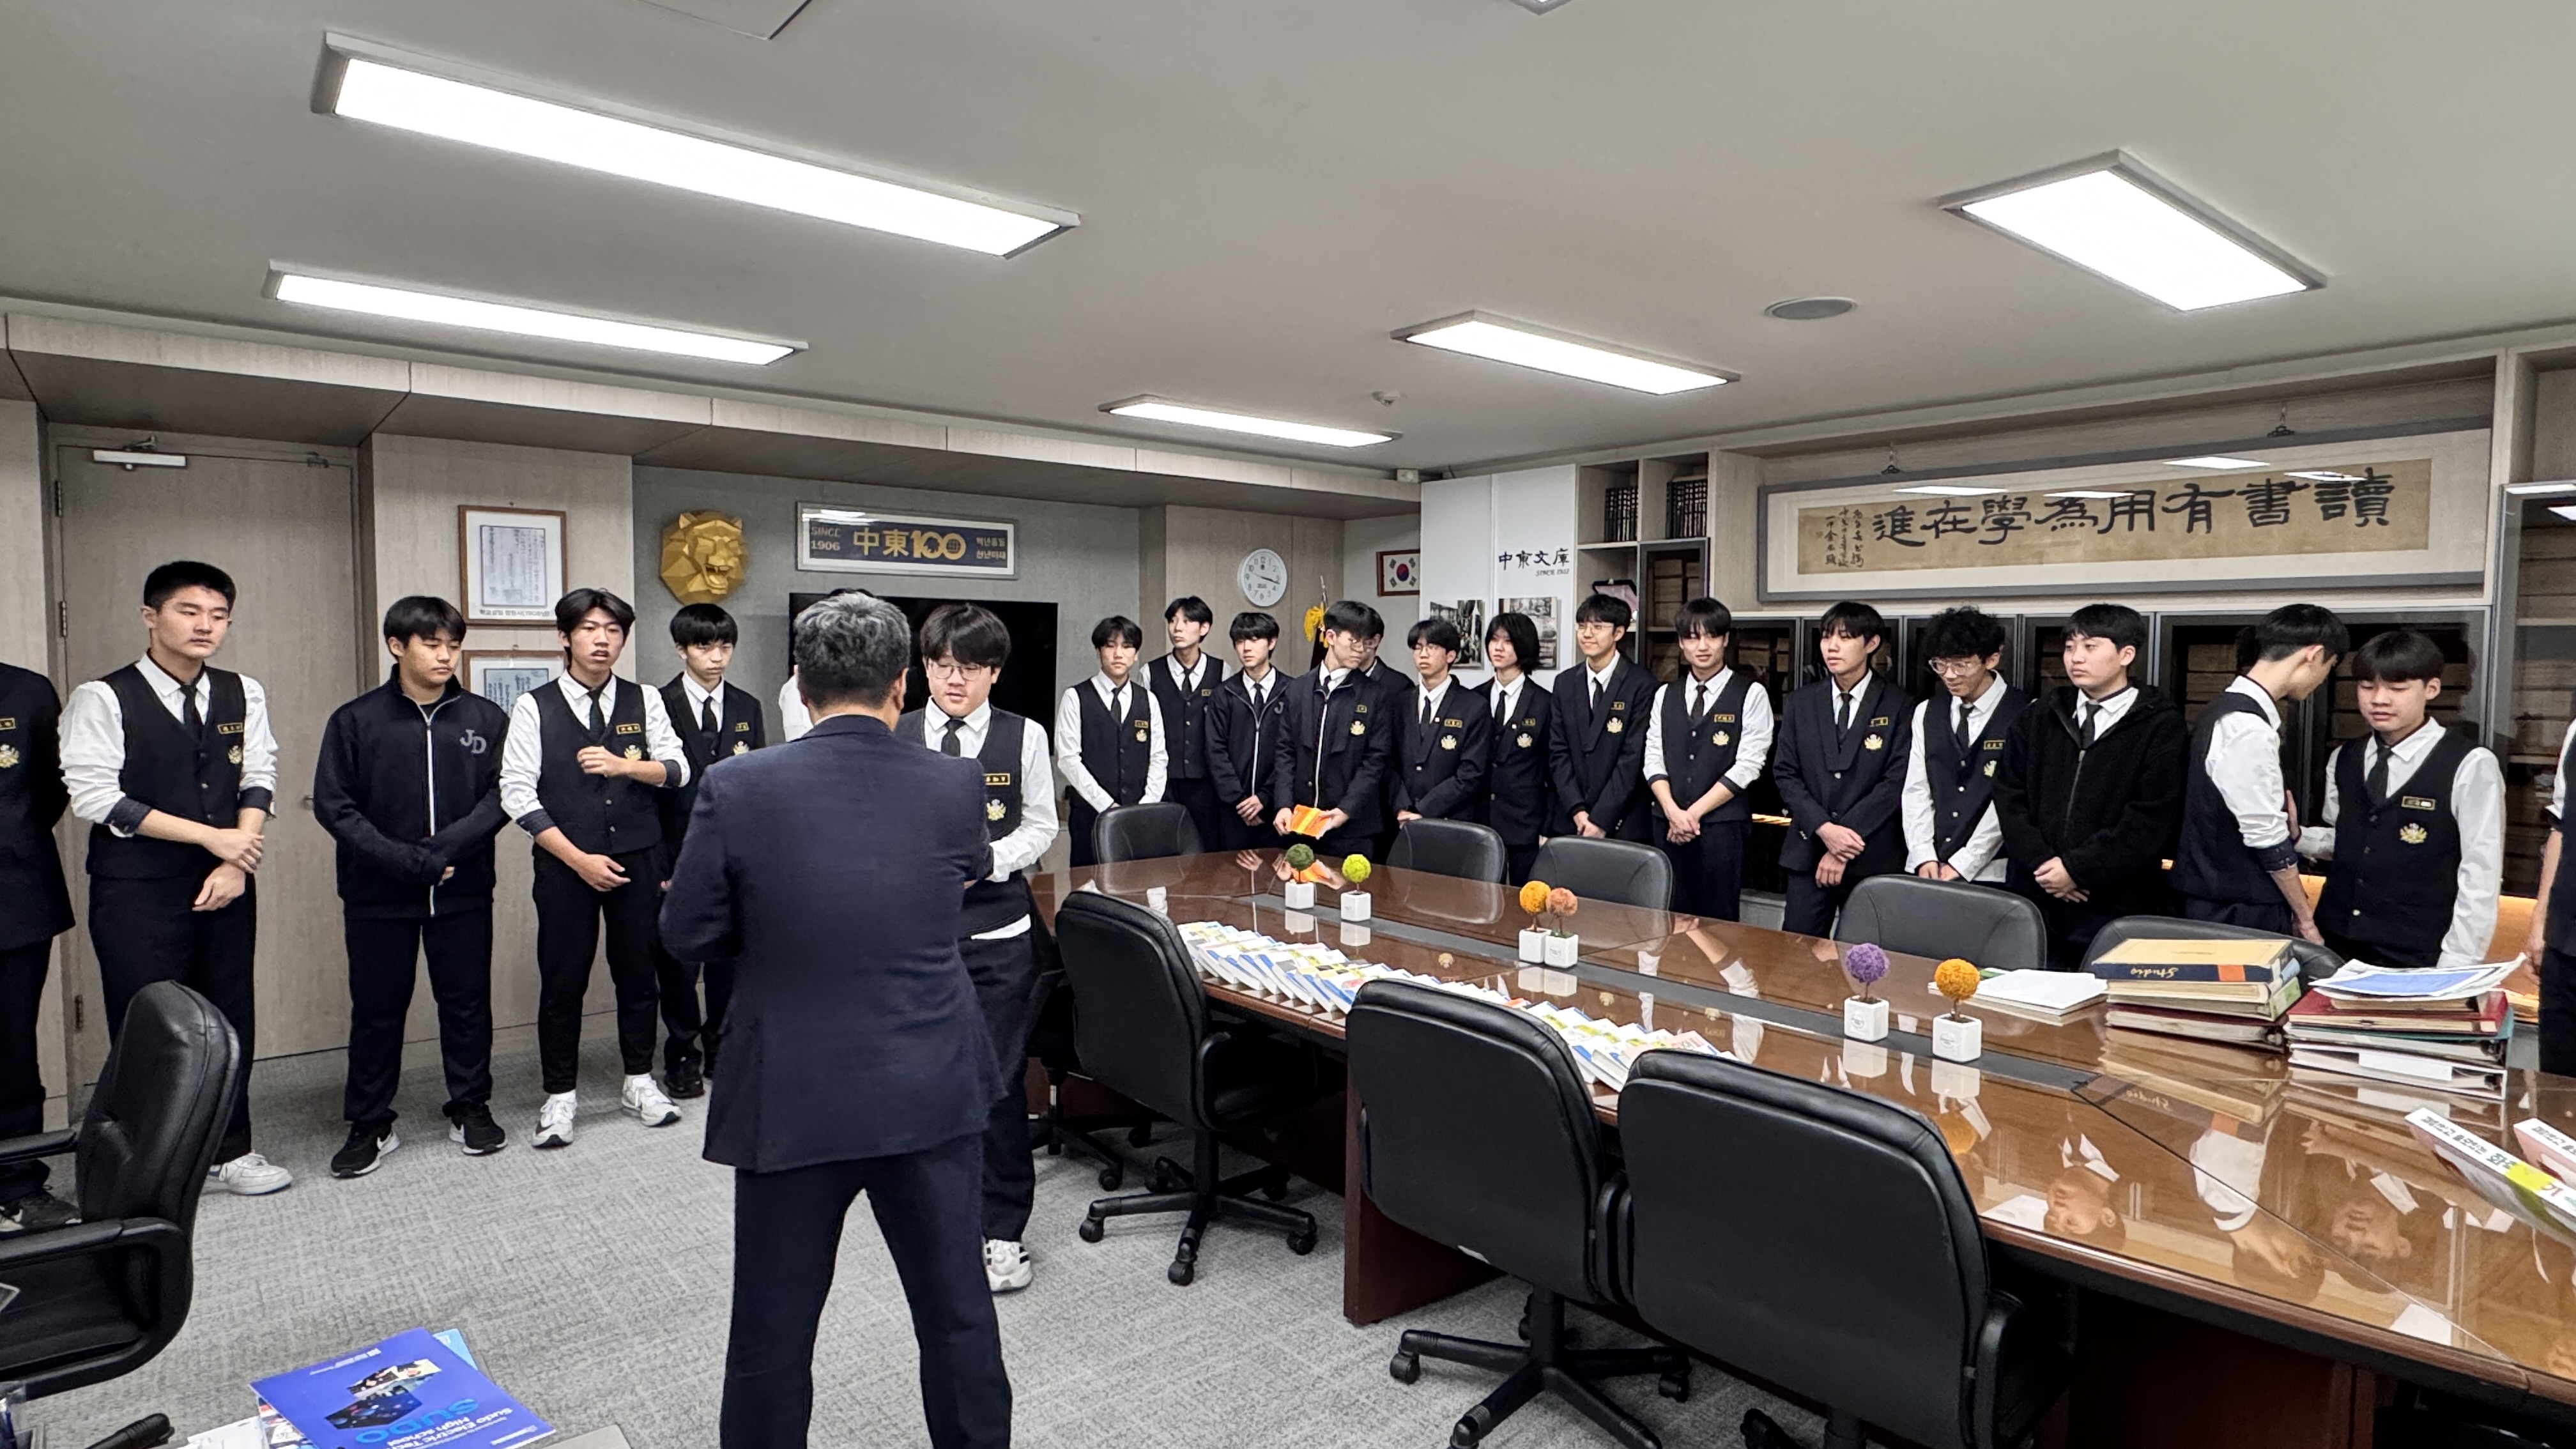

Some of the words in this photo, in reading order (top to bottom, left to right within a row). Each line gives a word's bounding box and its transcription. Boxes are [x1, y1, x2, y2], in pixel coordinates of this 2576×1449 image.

[811, 526, 841, 537] SINCE
[811, 540, 841, 551] 1906
[459, 728, 487, 754] JD
[2130, 967, 2179, 979] Studio
[355, 1398, 479, 1444] SUDO
[476, 1407, 513, 1423] Sudo
[436, 1416, 470, 1432] High
[387, 1429, 436, 1446] school
[422, 1422, 477, 1443] Electric
